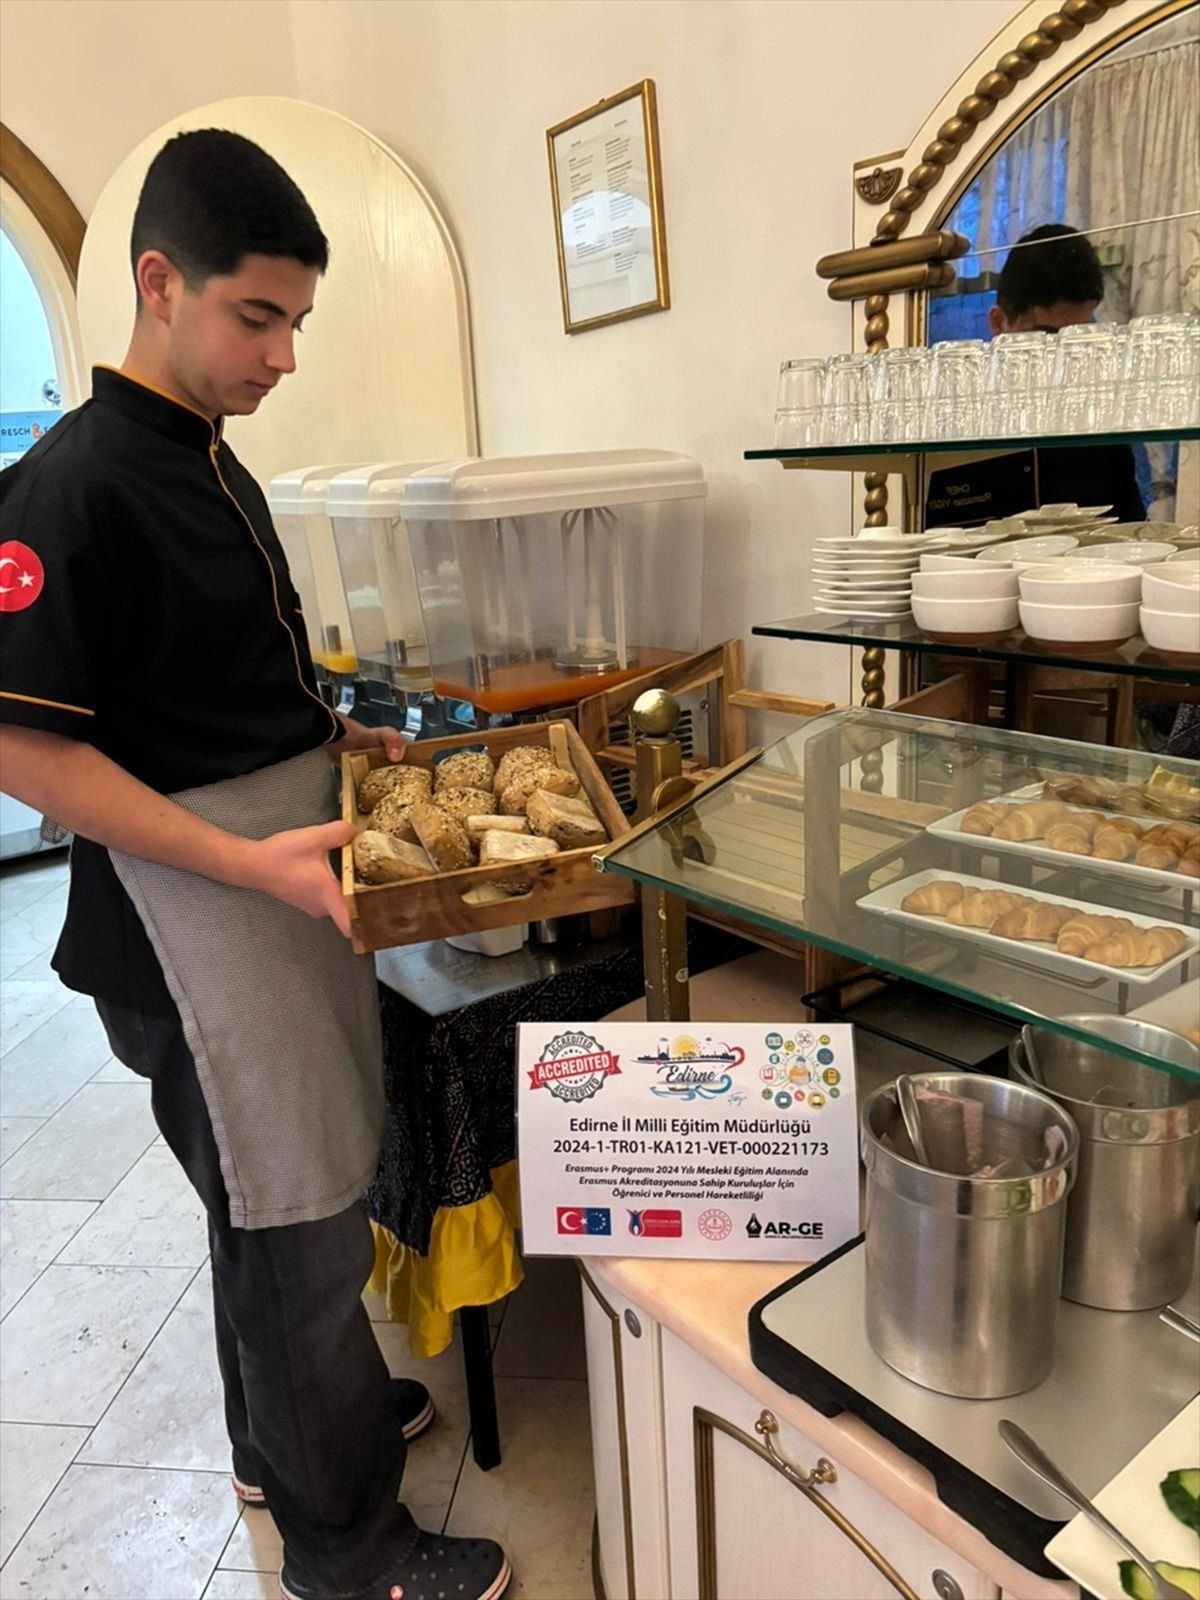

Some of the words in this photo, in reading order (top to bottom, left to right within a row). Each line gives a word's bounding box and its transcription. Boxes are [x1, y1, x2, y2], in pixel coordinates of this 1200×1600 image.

[1, 427, 30, 436] RESCH
[548, 1035, 593, 1056] ACCREDITED
[538, 1055, 610, 1080] ACCREDITED
[657, 1065, 716, 1083] Edirne
[553, 1078, 600, 1099] ACCREDITED
[569, 1118, 618, 1132] Edirne
[622, 1116, 631, 1132] İl
[636, 1119, 667, 1133] Milli
[671, 1119, 720, 1135] Eğitim
[724, 1119, 811, 1136] Müdürlüğü
[553, 1140, 829, 1156] 2024-1-TR01-KA121-VET-000221173
[565, 1164, 610, 1174] Erasmus+
[611, 1165, 654, 1175] Programı
[656, 1166, 679, 1174] 2024
[681, 1166, 695, 1174] Yılı
[696, 1166, 732, 1175] Mesleki
[734, 1166, 763, 1177] Eğitim
[765, 1167, 809, 1176] Alanında
[579, 1177, 618, 1185] Erasmus
[619, 1177, 698, 1188] Akreditasyonuna
[699, 1178, 726, 1188] Sahip
[727, 1179, 776, 1189] Kuruluşlar
[778, 1179, 795, 1189] İçin
[612, 1188, 650, 1199] Öğrenici
[665, 1190, 704, 1199] Personel
[706, 1190, 764, 1201] Hareketliliği
[764, 1222, 823, 1235] AR-GE
